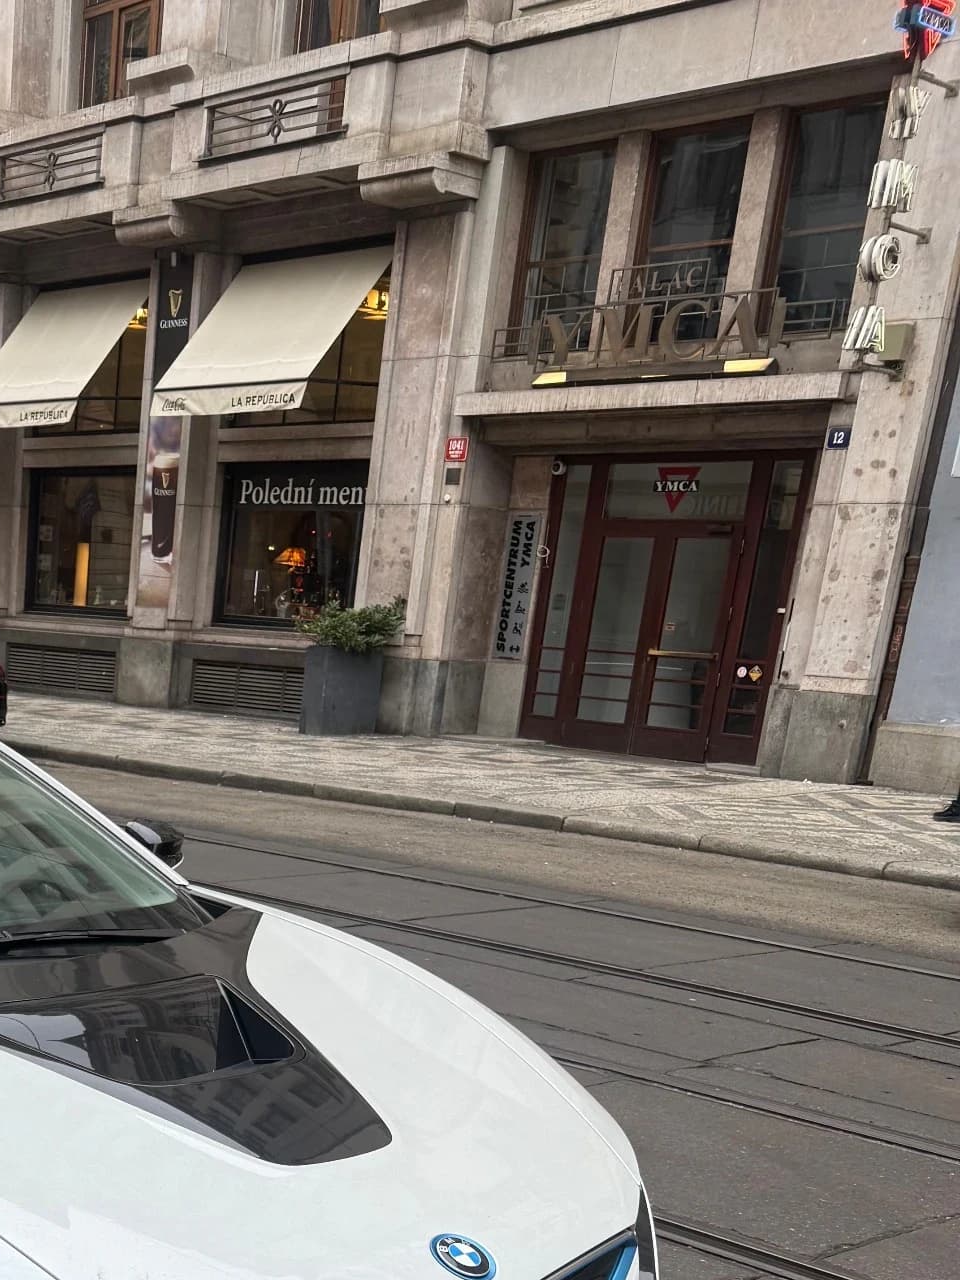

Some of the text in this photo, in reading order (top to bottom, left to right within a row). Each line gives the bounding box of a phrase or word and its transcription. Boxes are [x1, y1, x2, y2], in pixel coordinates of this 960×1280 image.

[159, 318, 189, 329] GUINNESS
[542, 292, 761, 367] YMCA
[231, 393, 296, 408] LA REPUBLICA
[449, 439, 465, 451] 1041
[832, 431, 845, 445] 12
[240, 478, 368, 505] Polední men
[655, 481, 697, 493] YMCA
[520, 520, 536, 568] YMCA
[496, 520, 523, 653] SPORTCENTRUM
